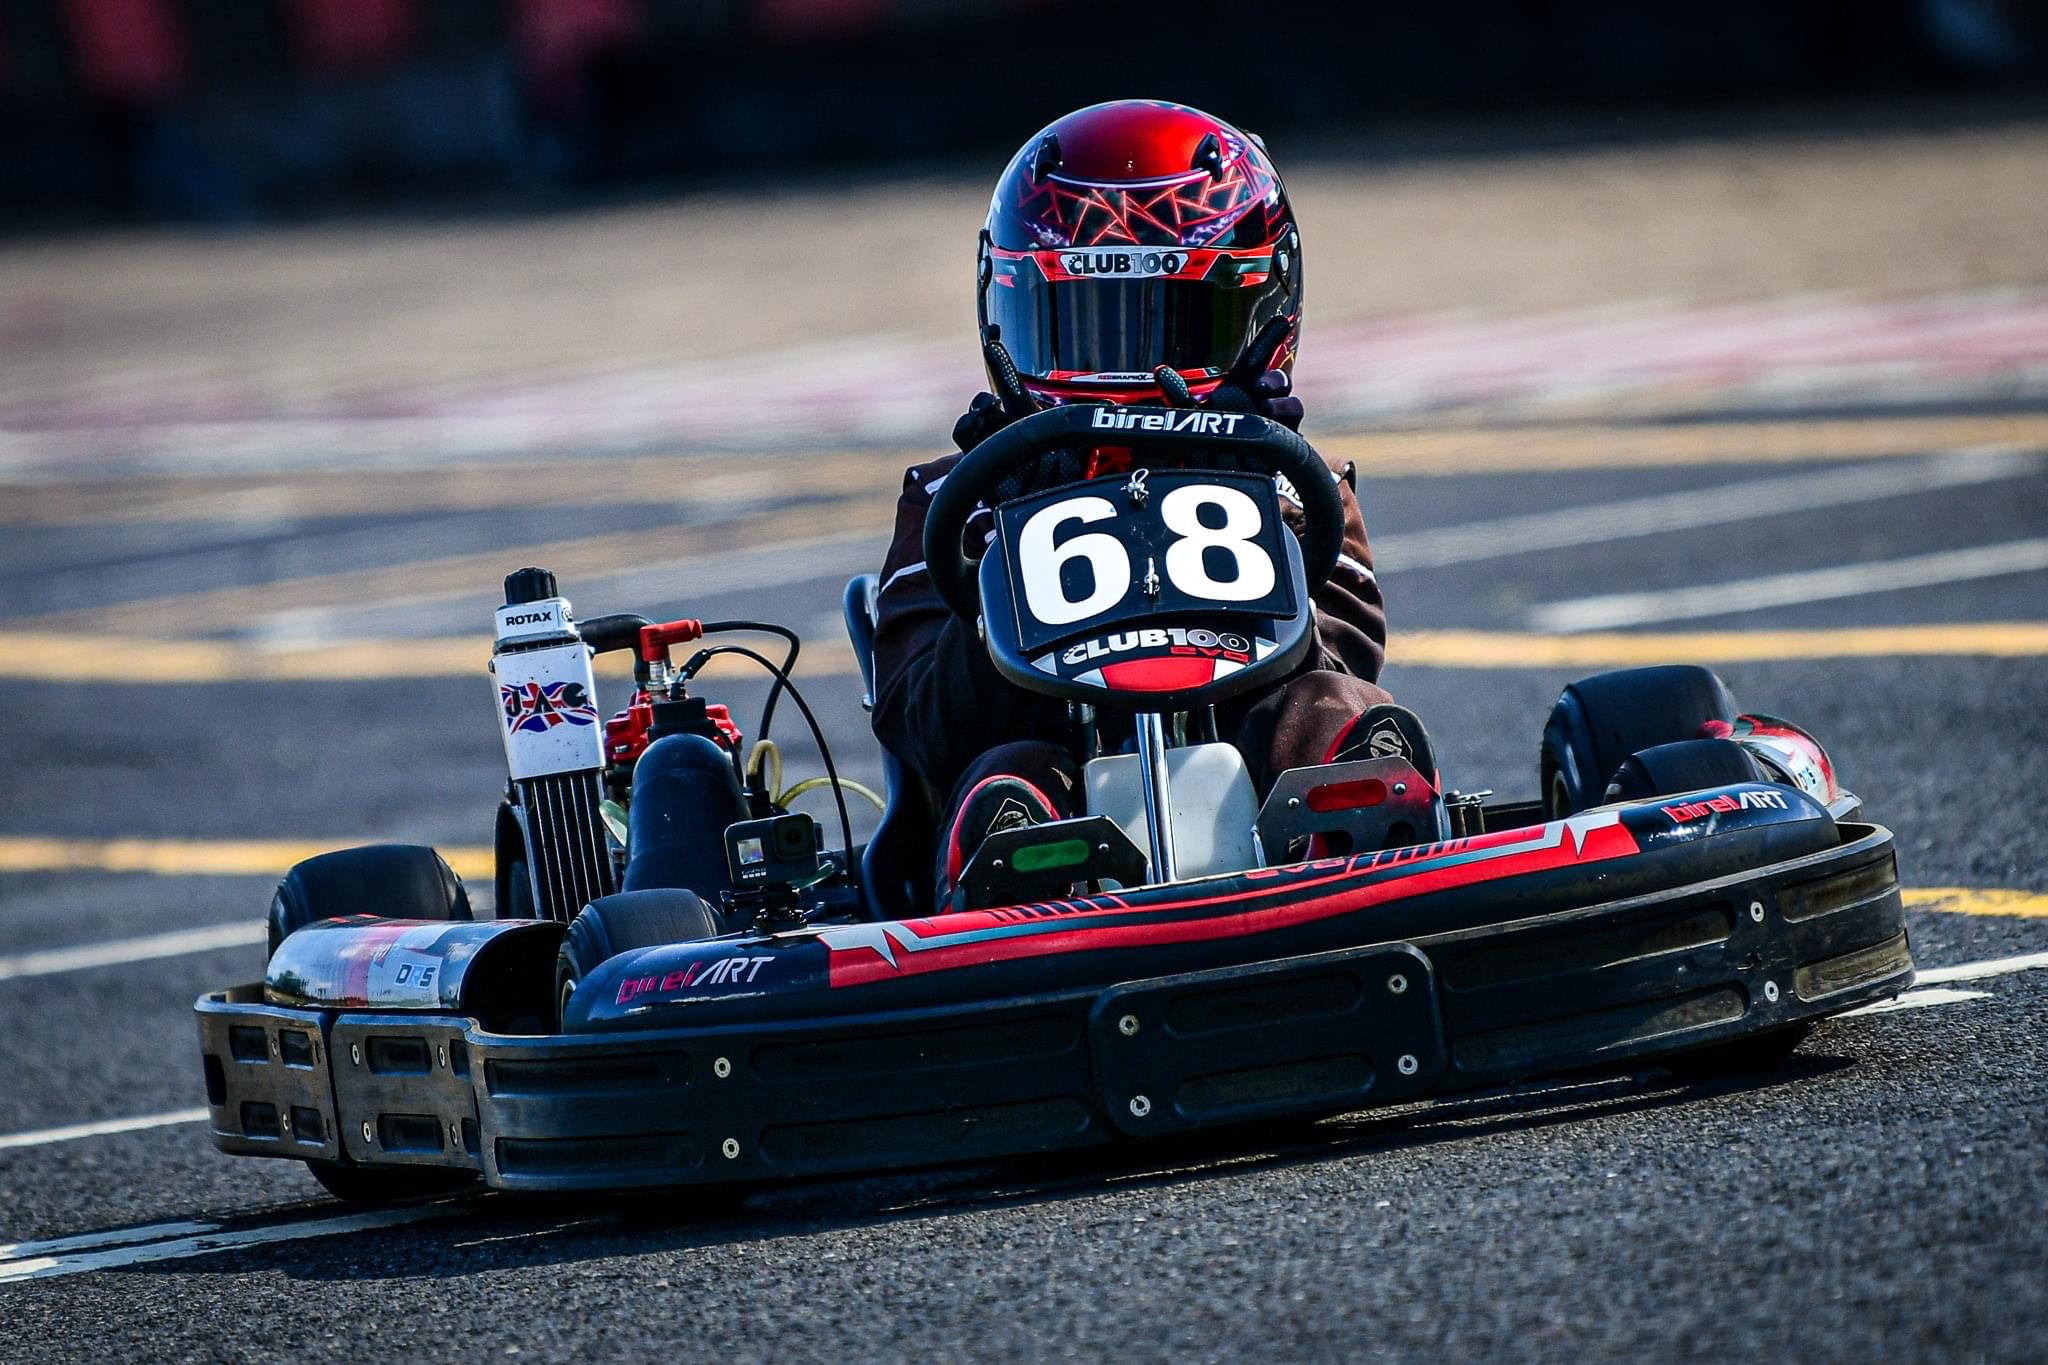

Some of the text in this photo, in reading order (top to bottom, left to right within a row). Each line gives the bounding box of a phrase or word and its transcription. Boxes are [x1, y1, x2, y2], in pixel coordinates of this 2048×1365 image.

[1068, 252, 1180, 274] CLUB100
[1092, 407, 1245, 435] birelART
[1019, 484, 1276, 626] 68
[505, 611, 552, 627] ROTAX
[1062, 627, 1251, 666] CLUB100
[394, 963, 436, 989] DRS
